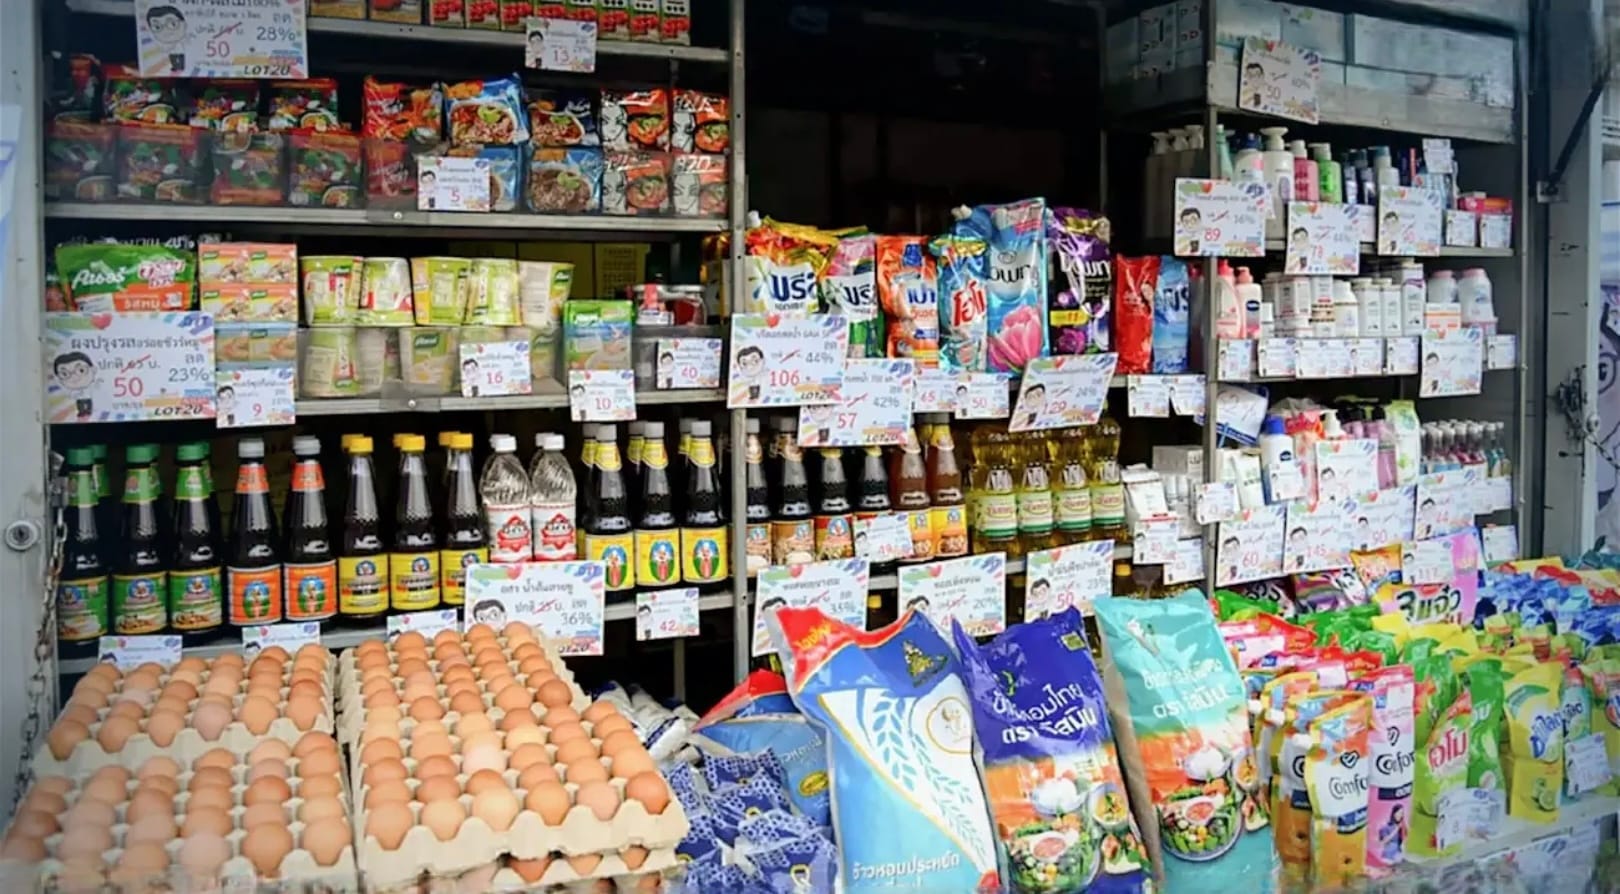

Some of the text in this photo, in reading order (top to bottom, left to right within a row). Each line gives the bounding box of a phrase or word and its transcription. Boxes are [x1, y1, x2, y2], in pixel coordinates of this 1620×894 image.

[256, 27, 296, 41] 28%
[206, 41, 230, 58] 50
[1204, 228, 1221, 241] 89
[168, 367, 210, 383] 23%
[486, 372, 503, 385] 16
[770, 369, 800, 387] 106
[112, 377, 144, 398] 50
[252, 403, 262, 417] 9
[595, 397, 611, 410] 10
[838, 413, 857, 429] 57
[1242, 552, 1259, 567] 60
[561, 613, 593, 626] 36%
